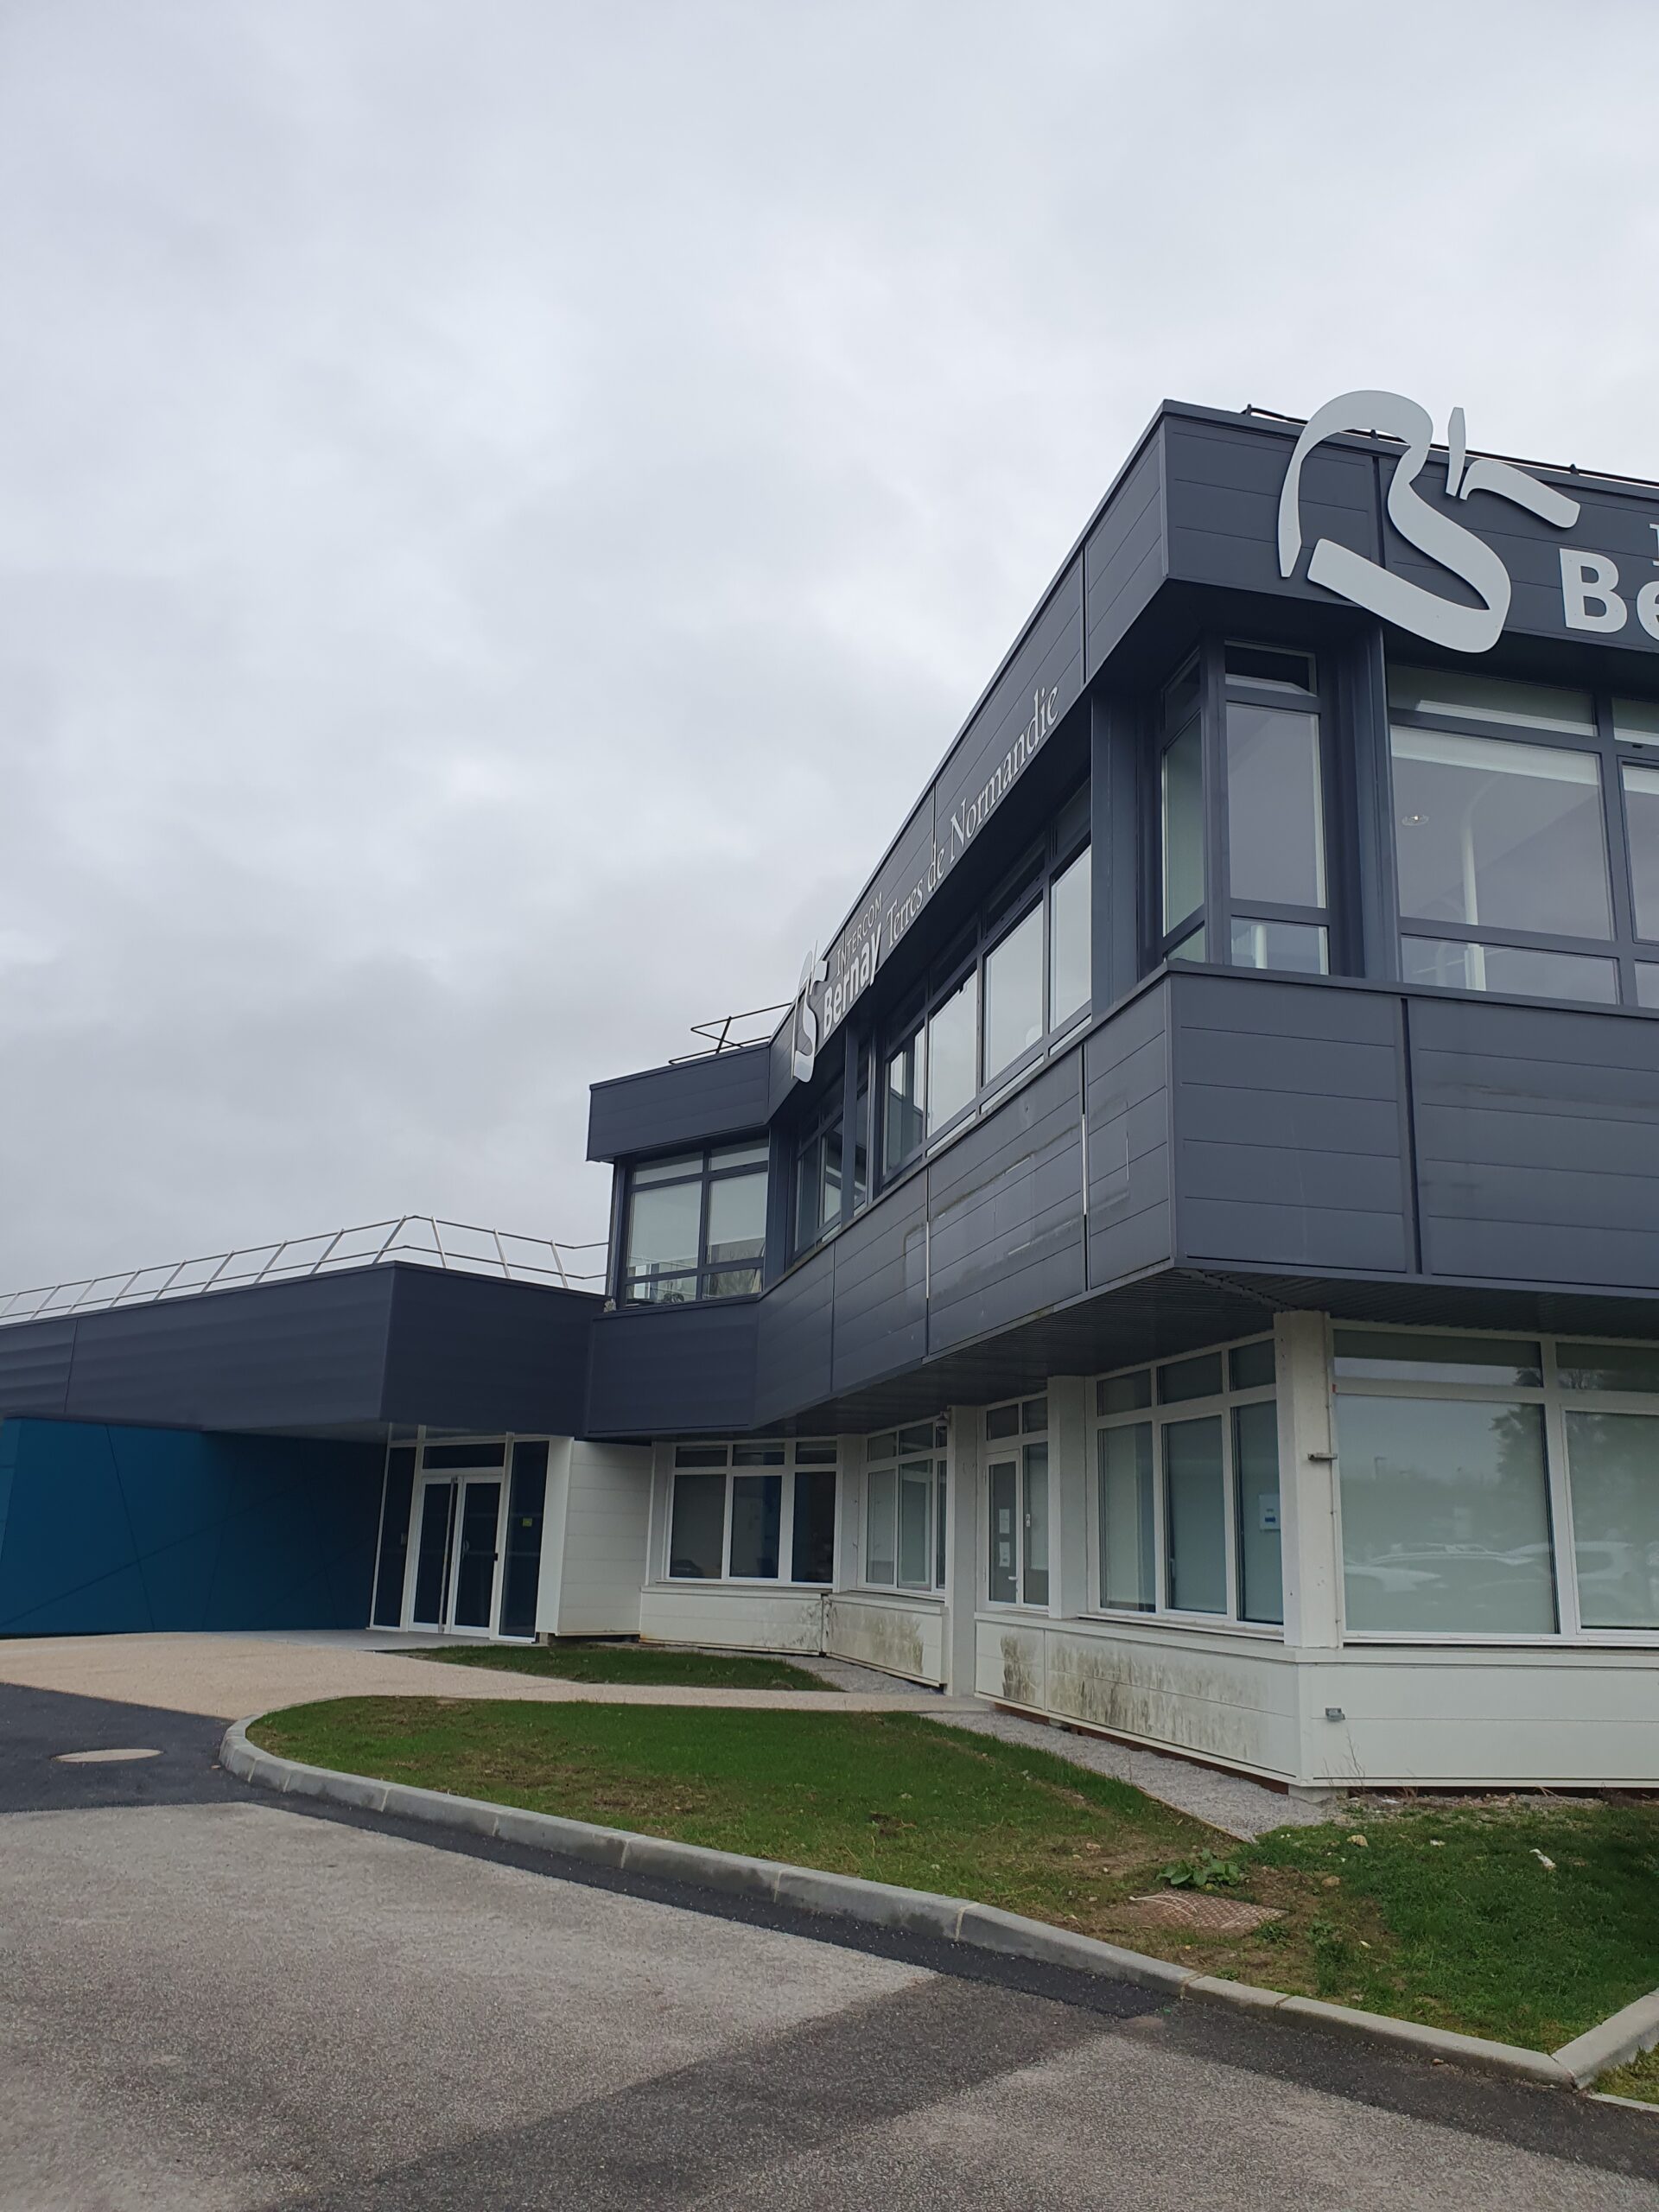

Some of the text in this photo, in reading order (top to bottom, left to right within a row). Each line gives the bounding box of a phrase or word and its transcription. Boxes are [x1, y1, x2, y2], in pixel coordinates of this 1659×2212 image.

[823, 686, 1059, 1040] Bernay Terres de Normandie
[836, 891, 883, 976] INTERCOM
